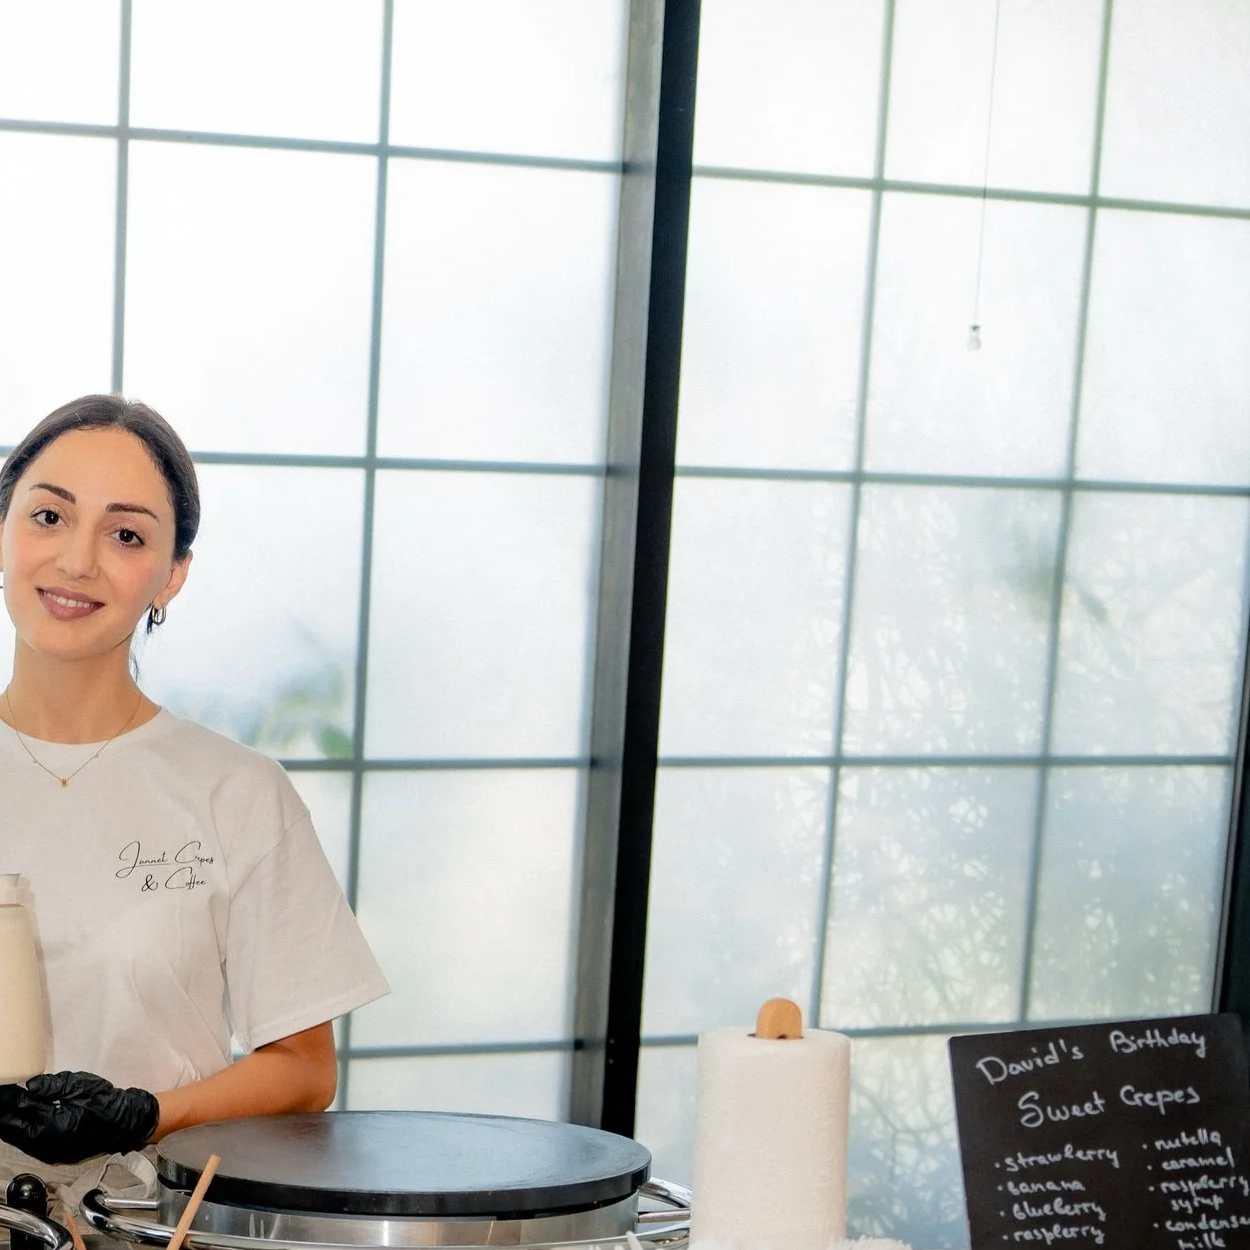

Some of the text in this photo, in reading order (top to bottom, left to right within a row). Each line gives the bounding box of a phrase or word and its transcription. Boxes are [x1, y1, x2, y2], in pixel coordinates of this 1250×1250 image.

[141, 874, 159, 892] &
[976, 1027, 1207, 1086] David's Birthday
[1017, 1085, 1201, 1128] Sweet Crepes
[1154, 1128, 1222, 1151] nutella
[1004, 1143, 1120, 1172] strawberry
[1161, 1146, 1235, 1170] caramel
[1007, 1180, 1086, 1196] banana
[1160, 1174, 1250, 1197] raspberry
[1012, 1197, 1106, 1221] blueberry
[1171, 1194, 1224, 1214] syrup
[1165, 1213, 1250, 1232] condense
[1013, 1223, 1105, 1246] raspberry
[1178, 1231, 1226, 1250] milk
